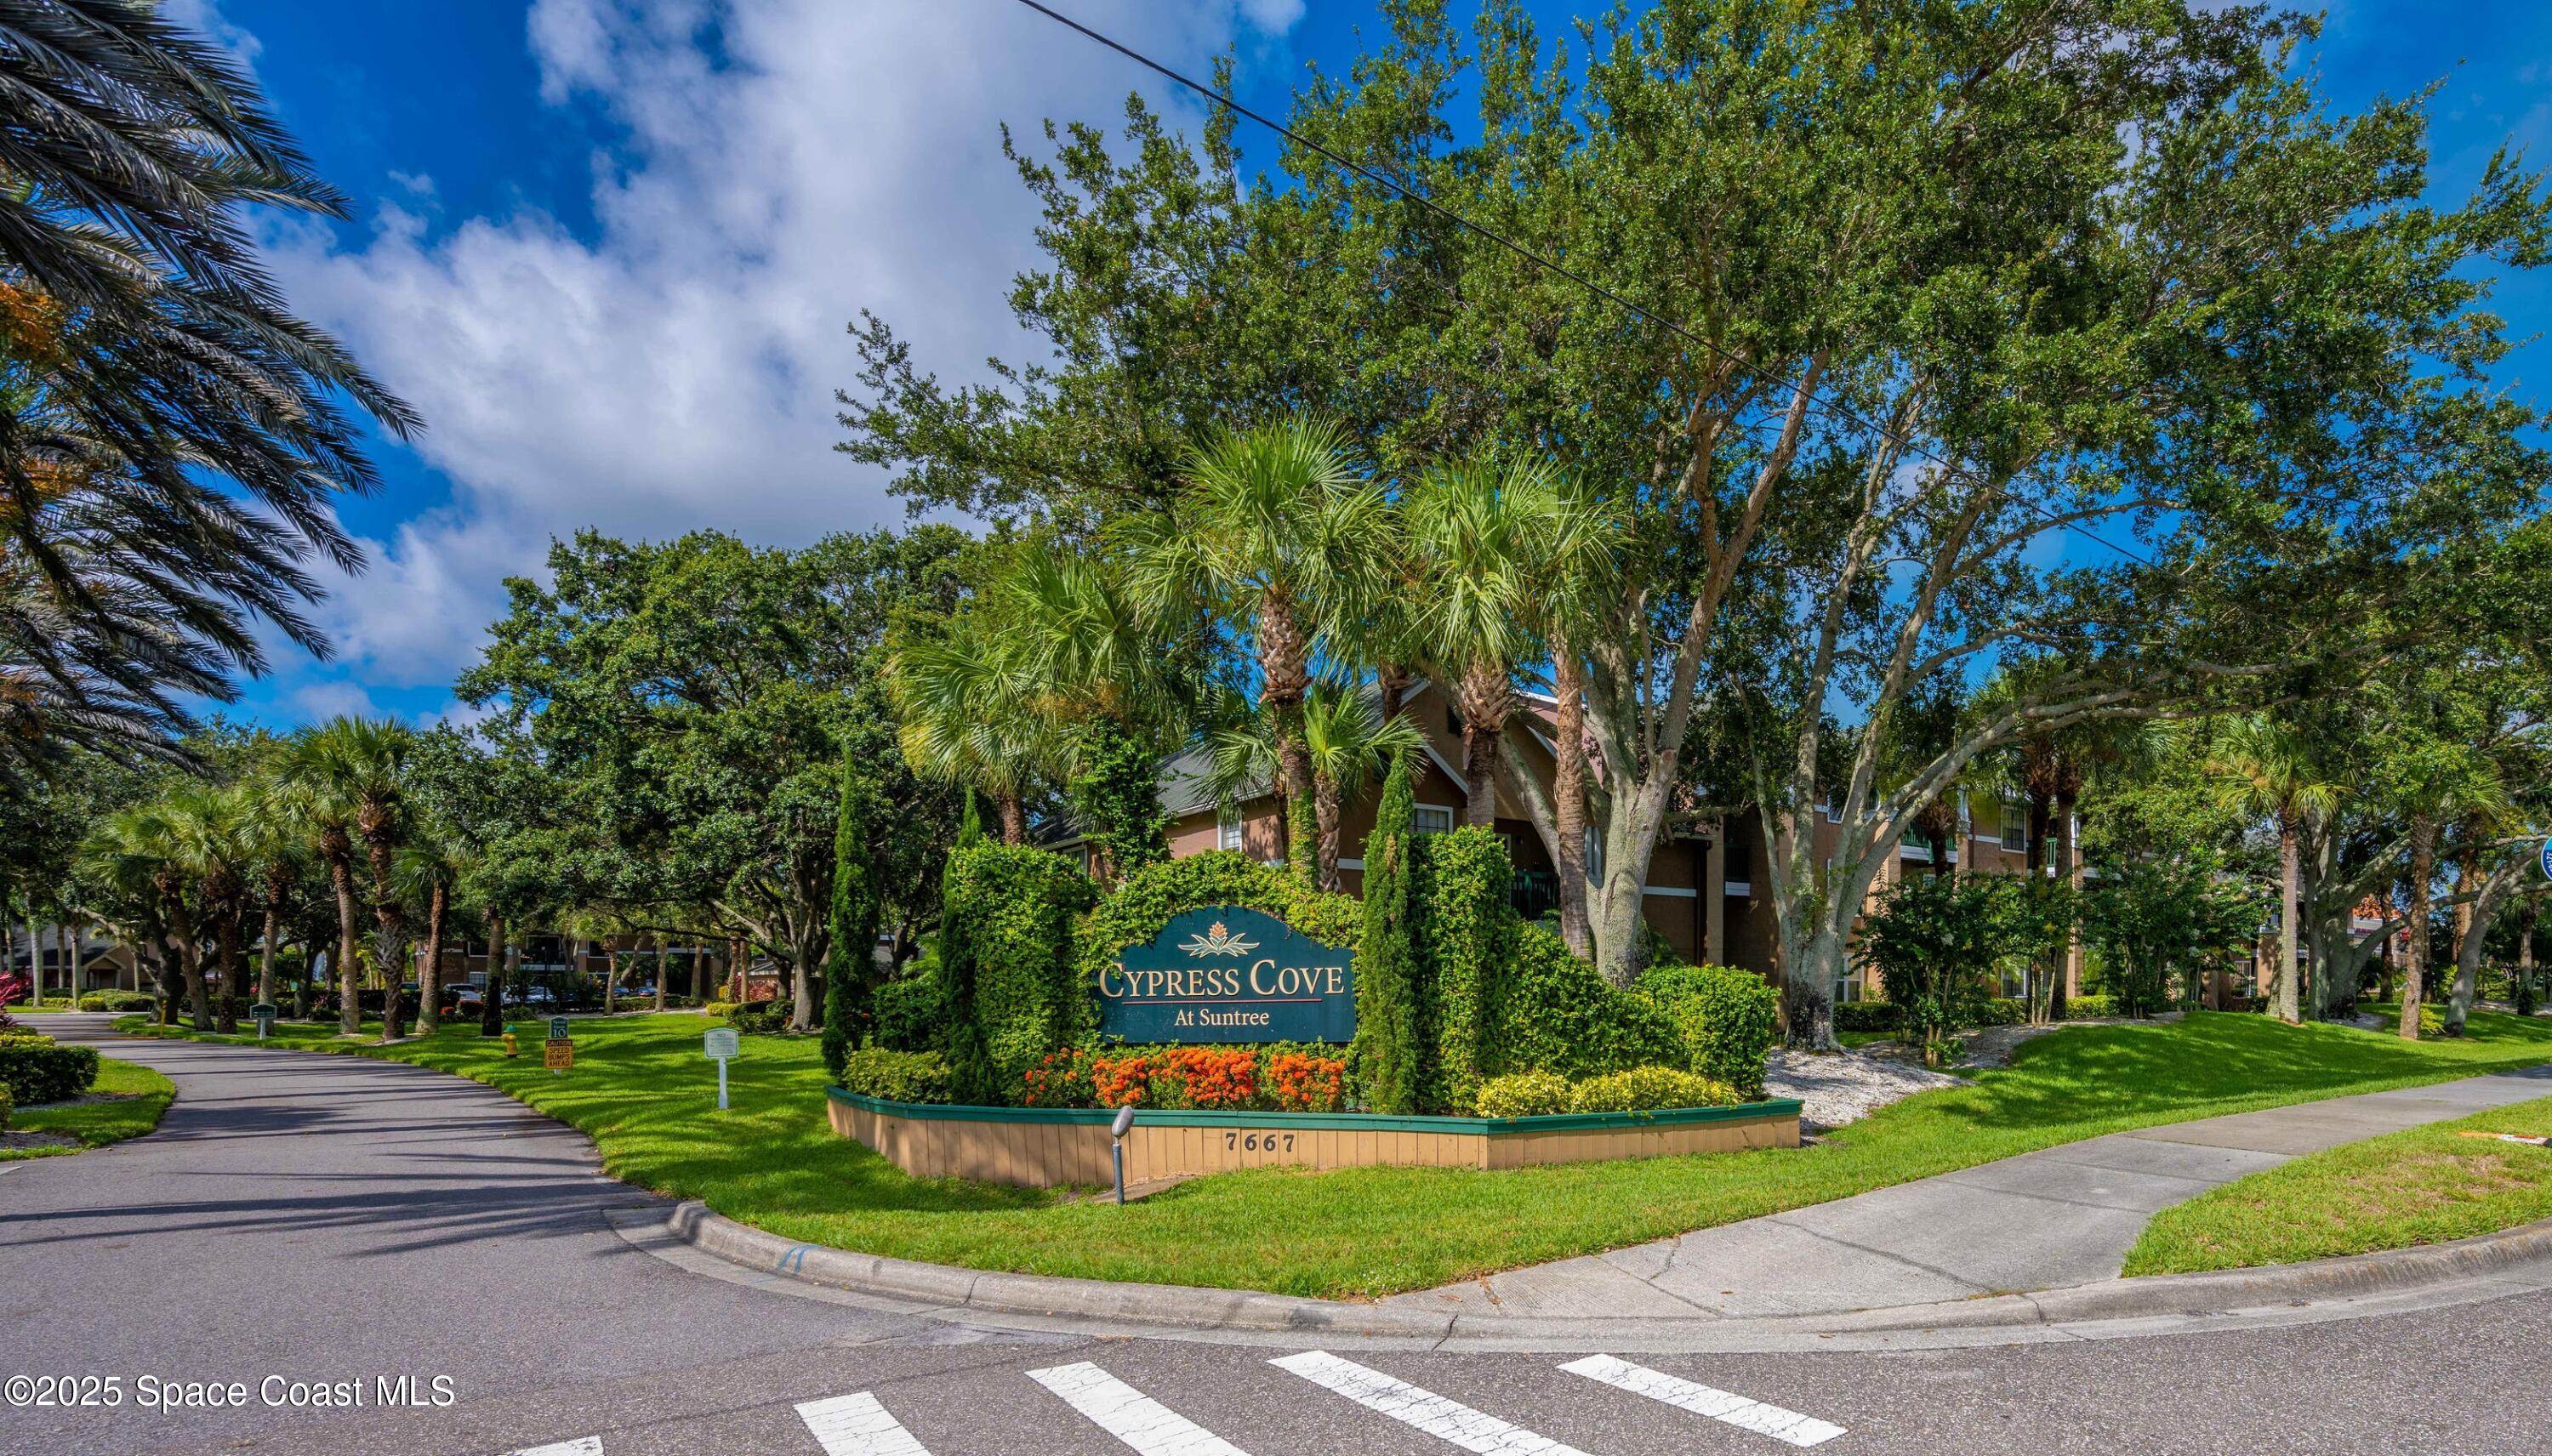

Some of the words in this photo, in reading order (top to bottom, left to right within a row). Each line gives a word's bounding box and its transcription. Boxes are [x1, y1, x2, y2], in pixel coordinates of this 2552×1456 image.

[1099, 962, 1239, 998] CYPRESS
[1250, 958, 1345, 996] COVE
[1174, 1008, 1194, 1027] At
[1199, 1008, 1270, 1027] Suntree
[553, 1028, 566, 1038] 10
[1225, 1132, 1295, 1153] 7667
